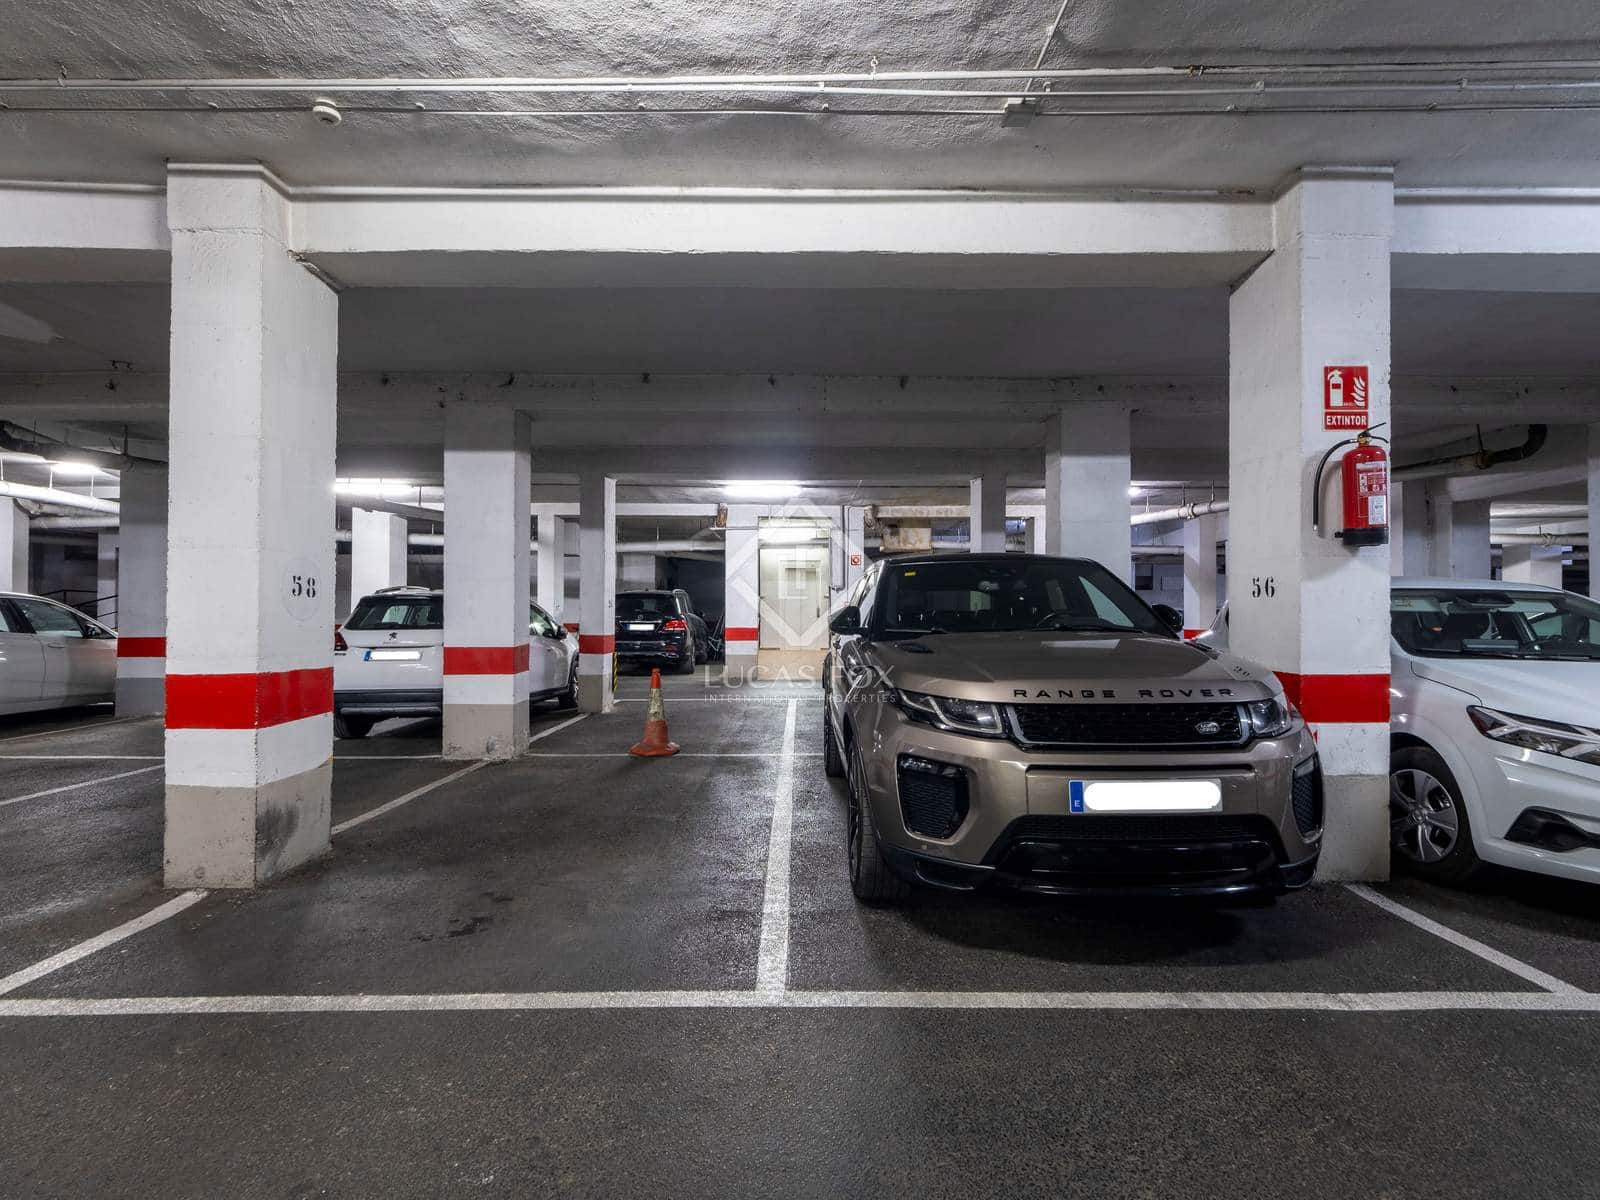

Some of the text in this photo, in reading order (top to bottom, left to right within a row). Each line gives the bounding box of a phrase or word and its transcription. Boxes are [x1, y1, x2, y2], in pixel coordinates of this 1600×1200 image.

[1326, 415, 1367, 426] EXTINTOR
[291, 575, 316, 598] 58
[1252, 576, 1275, 598] 56
[1013, 688, 1234, 699] RANGE ROVER
[1074, 799, 1081, 808] E
